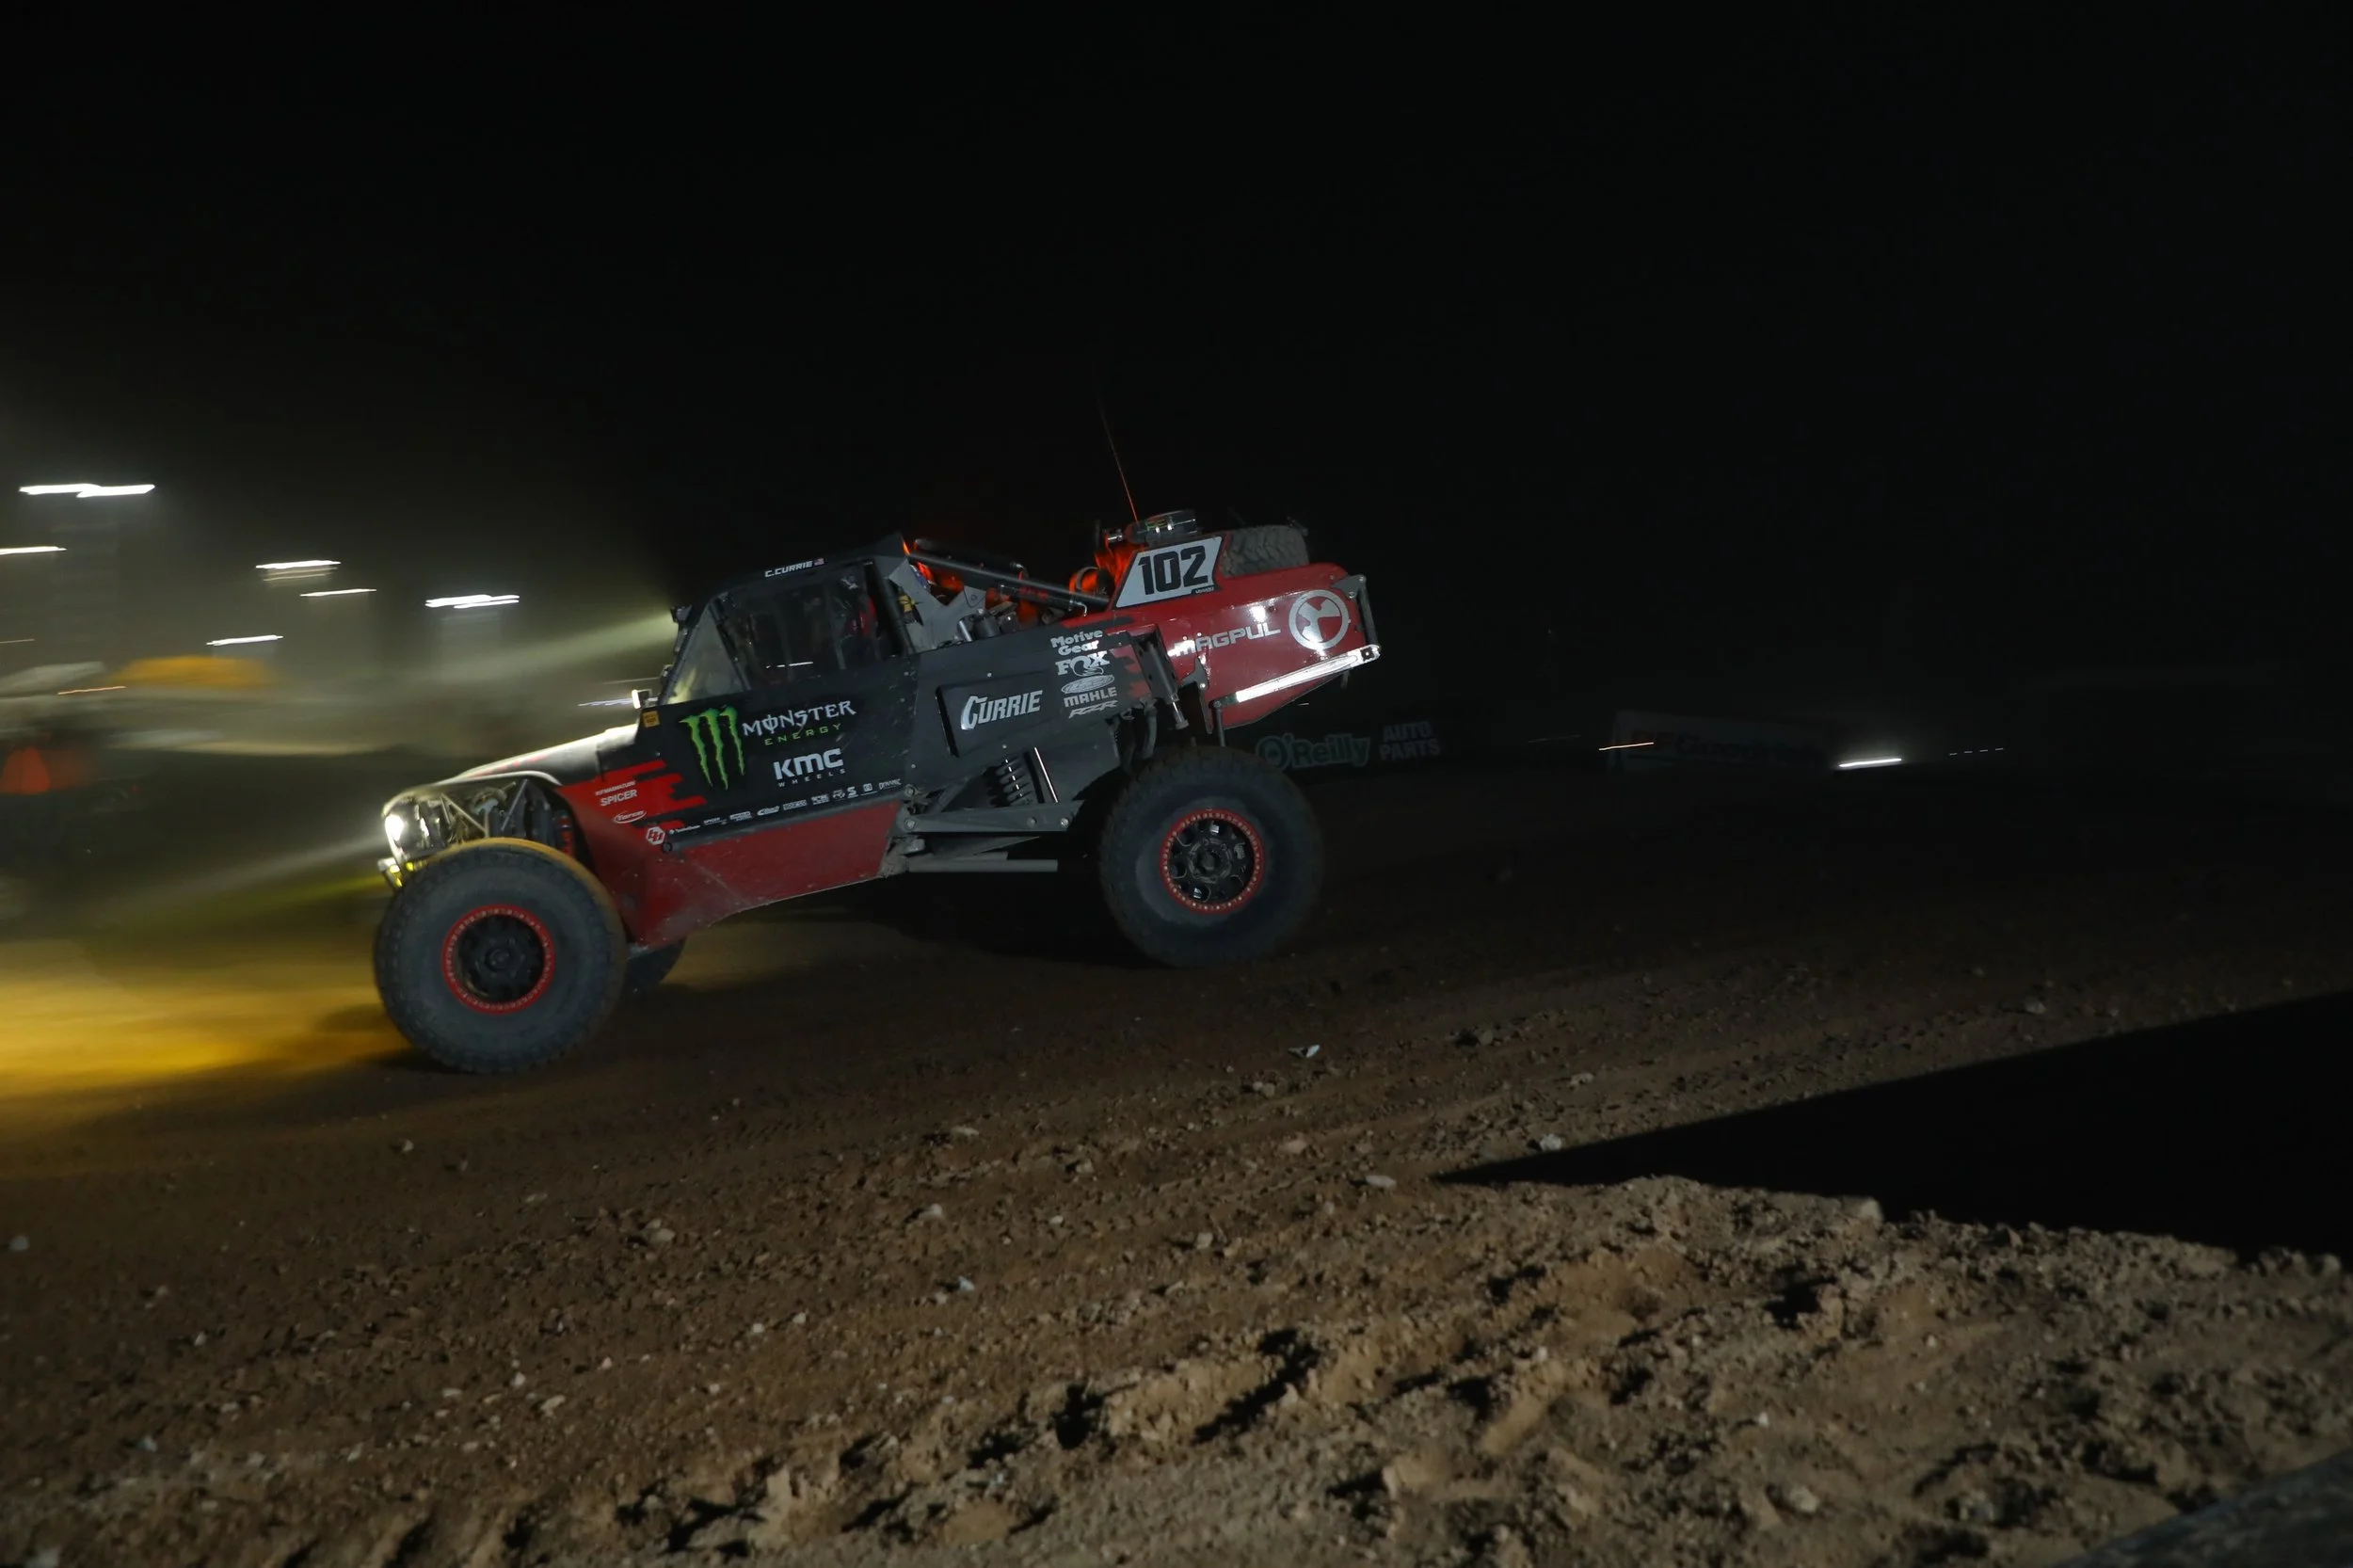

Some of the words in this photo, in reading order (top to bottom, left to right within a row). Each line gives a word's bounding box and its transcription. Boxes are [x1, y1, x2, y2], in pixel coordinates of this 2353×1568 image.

[764, 560, 813, 578] C.CURRIE
[1138, 545, 1209, 595] 102
[1050, 630, 1103, 648] Motive
[1058, 640, 1099, 656] Gear
[1173, 622, 1281, 656] MAGPUL
[1055, 650, 1111, 677] FOX
[1064, 686, 1118, 708] MAHLE
[742, 700, 856, 737] MONSTER
[960, 690, 1043, 730] CURRIE
[764, 723, 840, 746] ENERGY
[1383, 721, 1433, 743] AUTO
[1256, 732, 1370, 772] O'Reilly
[1379, 738, 1442, 761] PARTS
[773, 747, 844, 780] KMC
[778, 768, 846, 788] WHEELS
[600, 789, 638, 807] SPICER
